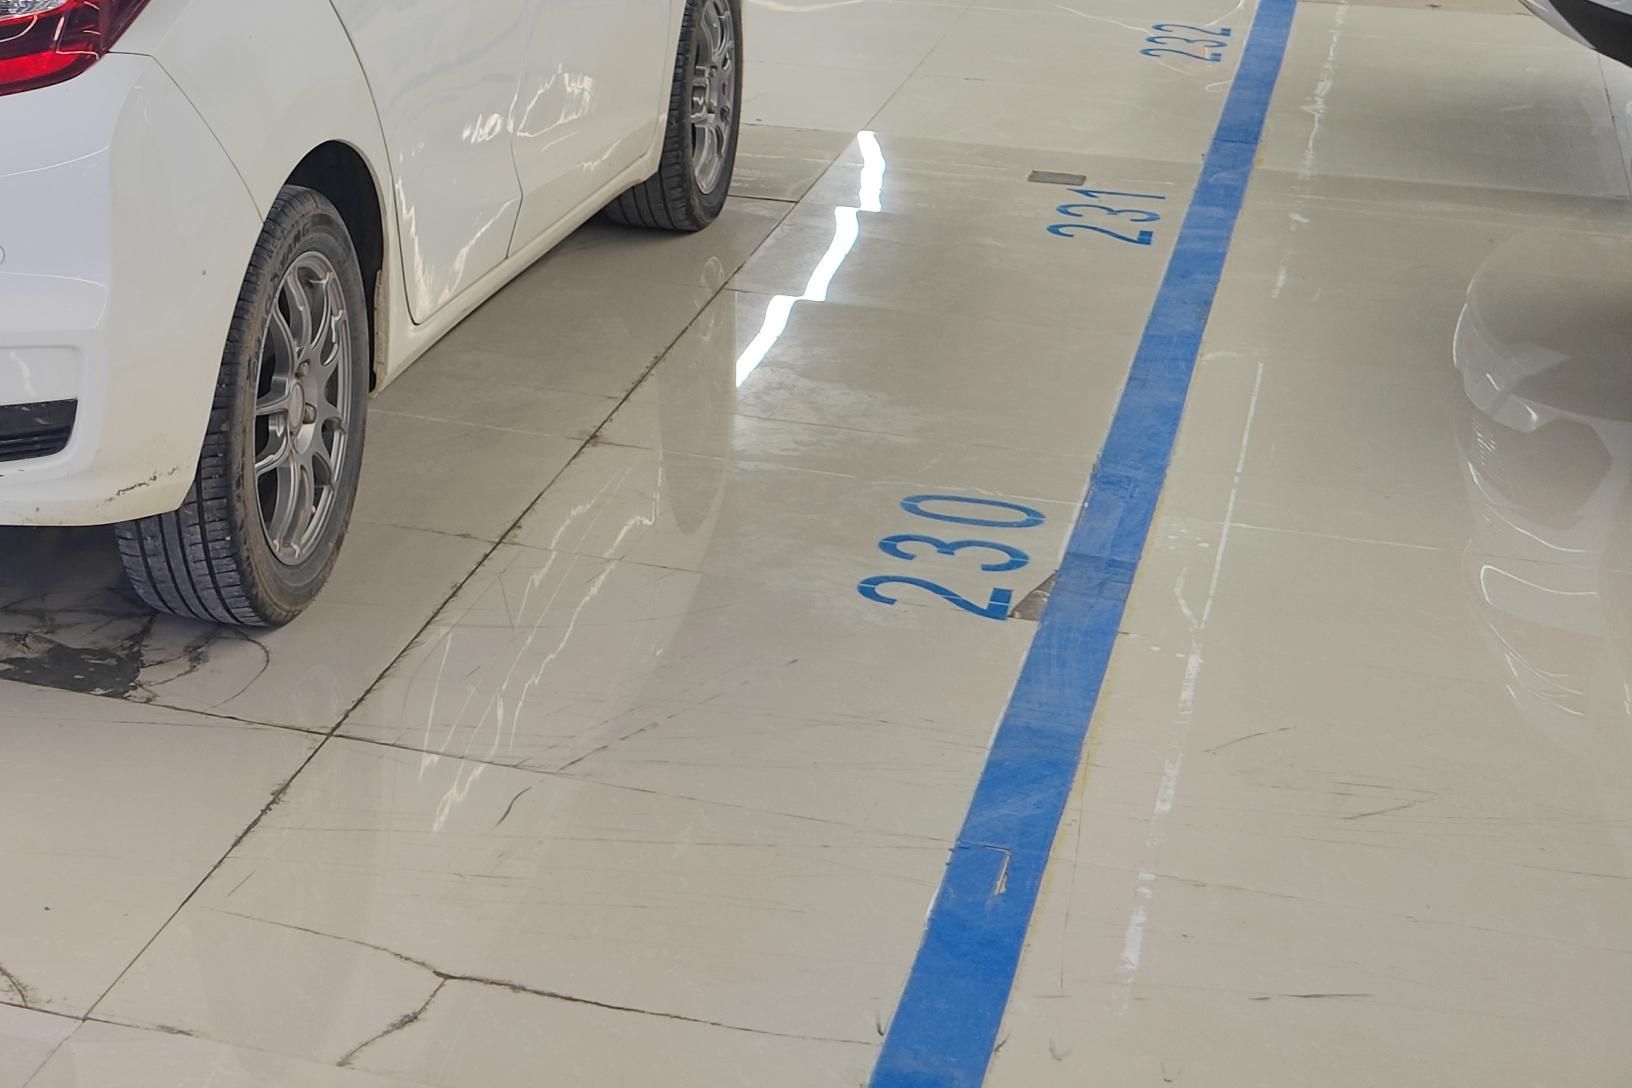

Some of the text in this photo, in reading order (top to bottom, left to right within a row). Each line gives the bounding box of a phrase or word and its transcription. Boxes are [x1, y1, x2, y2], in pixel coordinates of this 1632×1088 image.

[1139, 23, 1232, 63] 232
[1046, 187, 1166, 246] 231
[857, 494, 1046, 621] 230
